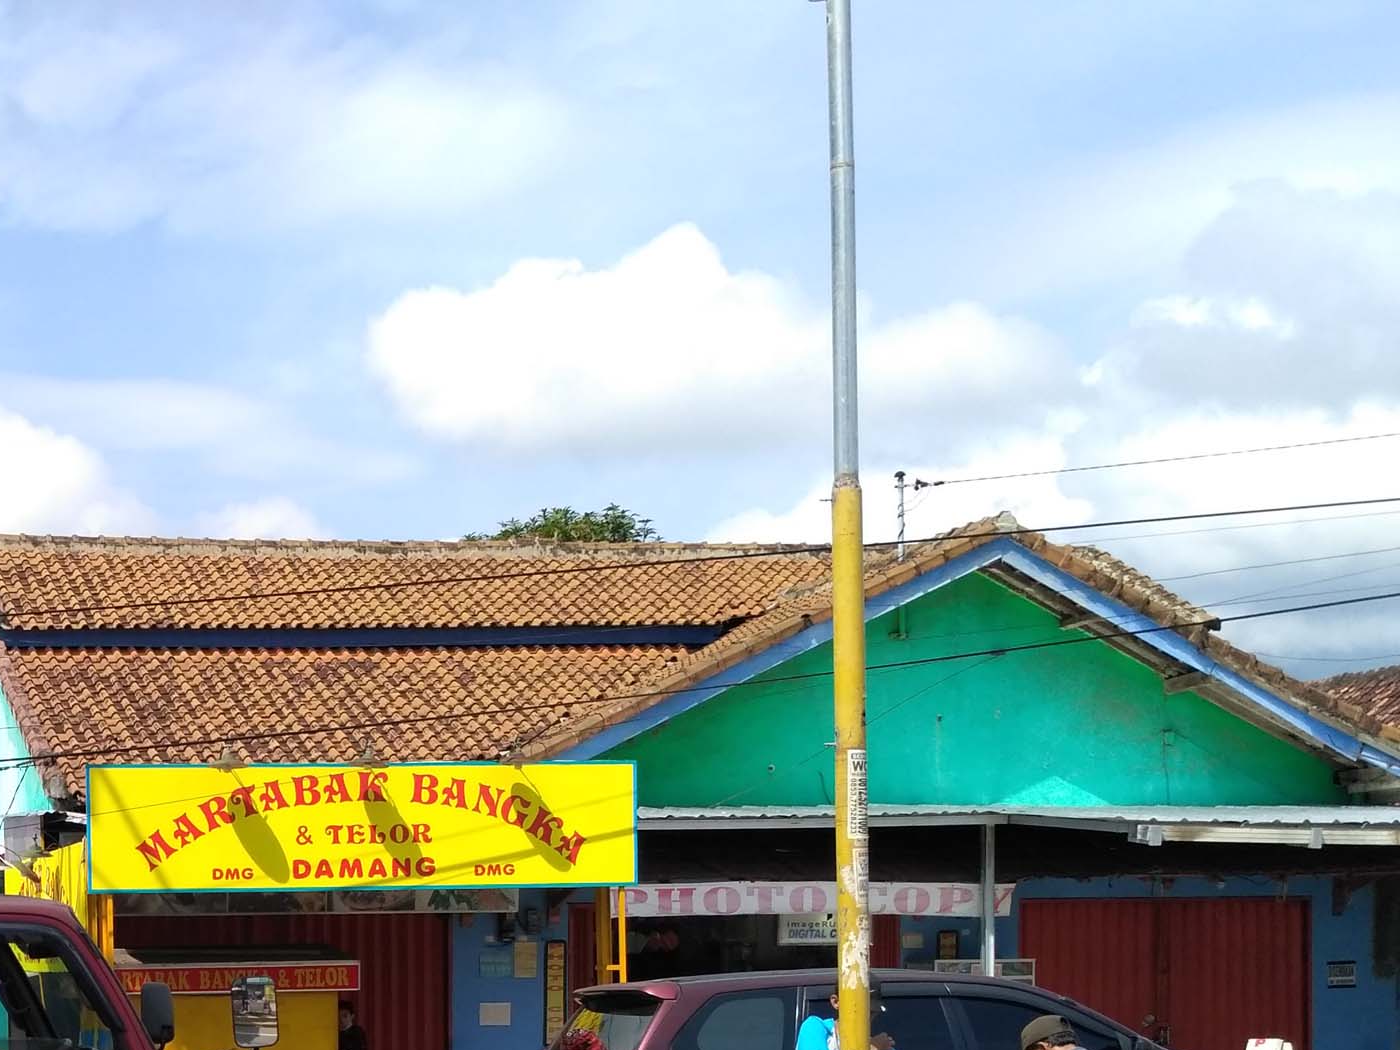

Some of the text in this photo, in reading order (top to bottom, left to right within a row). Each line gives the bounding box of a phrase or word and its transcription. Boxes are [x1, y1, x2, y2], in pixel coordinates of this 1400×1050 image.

[135, 772, 586, 872] MARTABAK BANGKA
[296, 824, 433, 845] & TELOR
[212, 857, 516, 881] DMG DAMANG DMG
[612, 886, 828, 915] PHOTO
[789, 929, 826, 938] DIGITAL
[279, 969, 290, 987] &
[295, 967, 349, 987] TELOR
